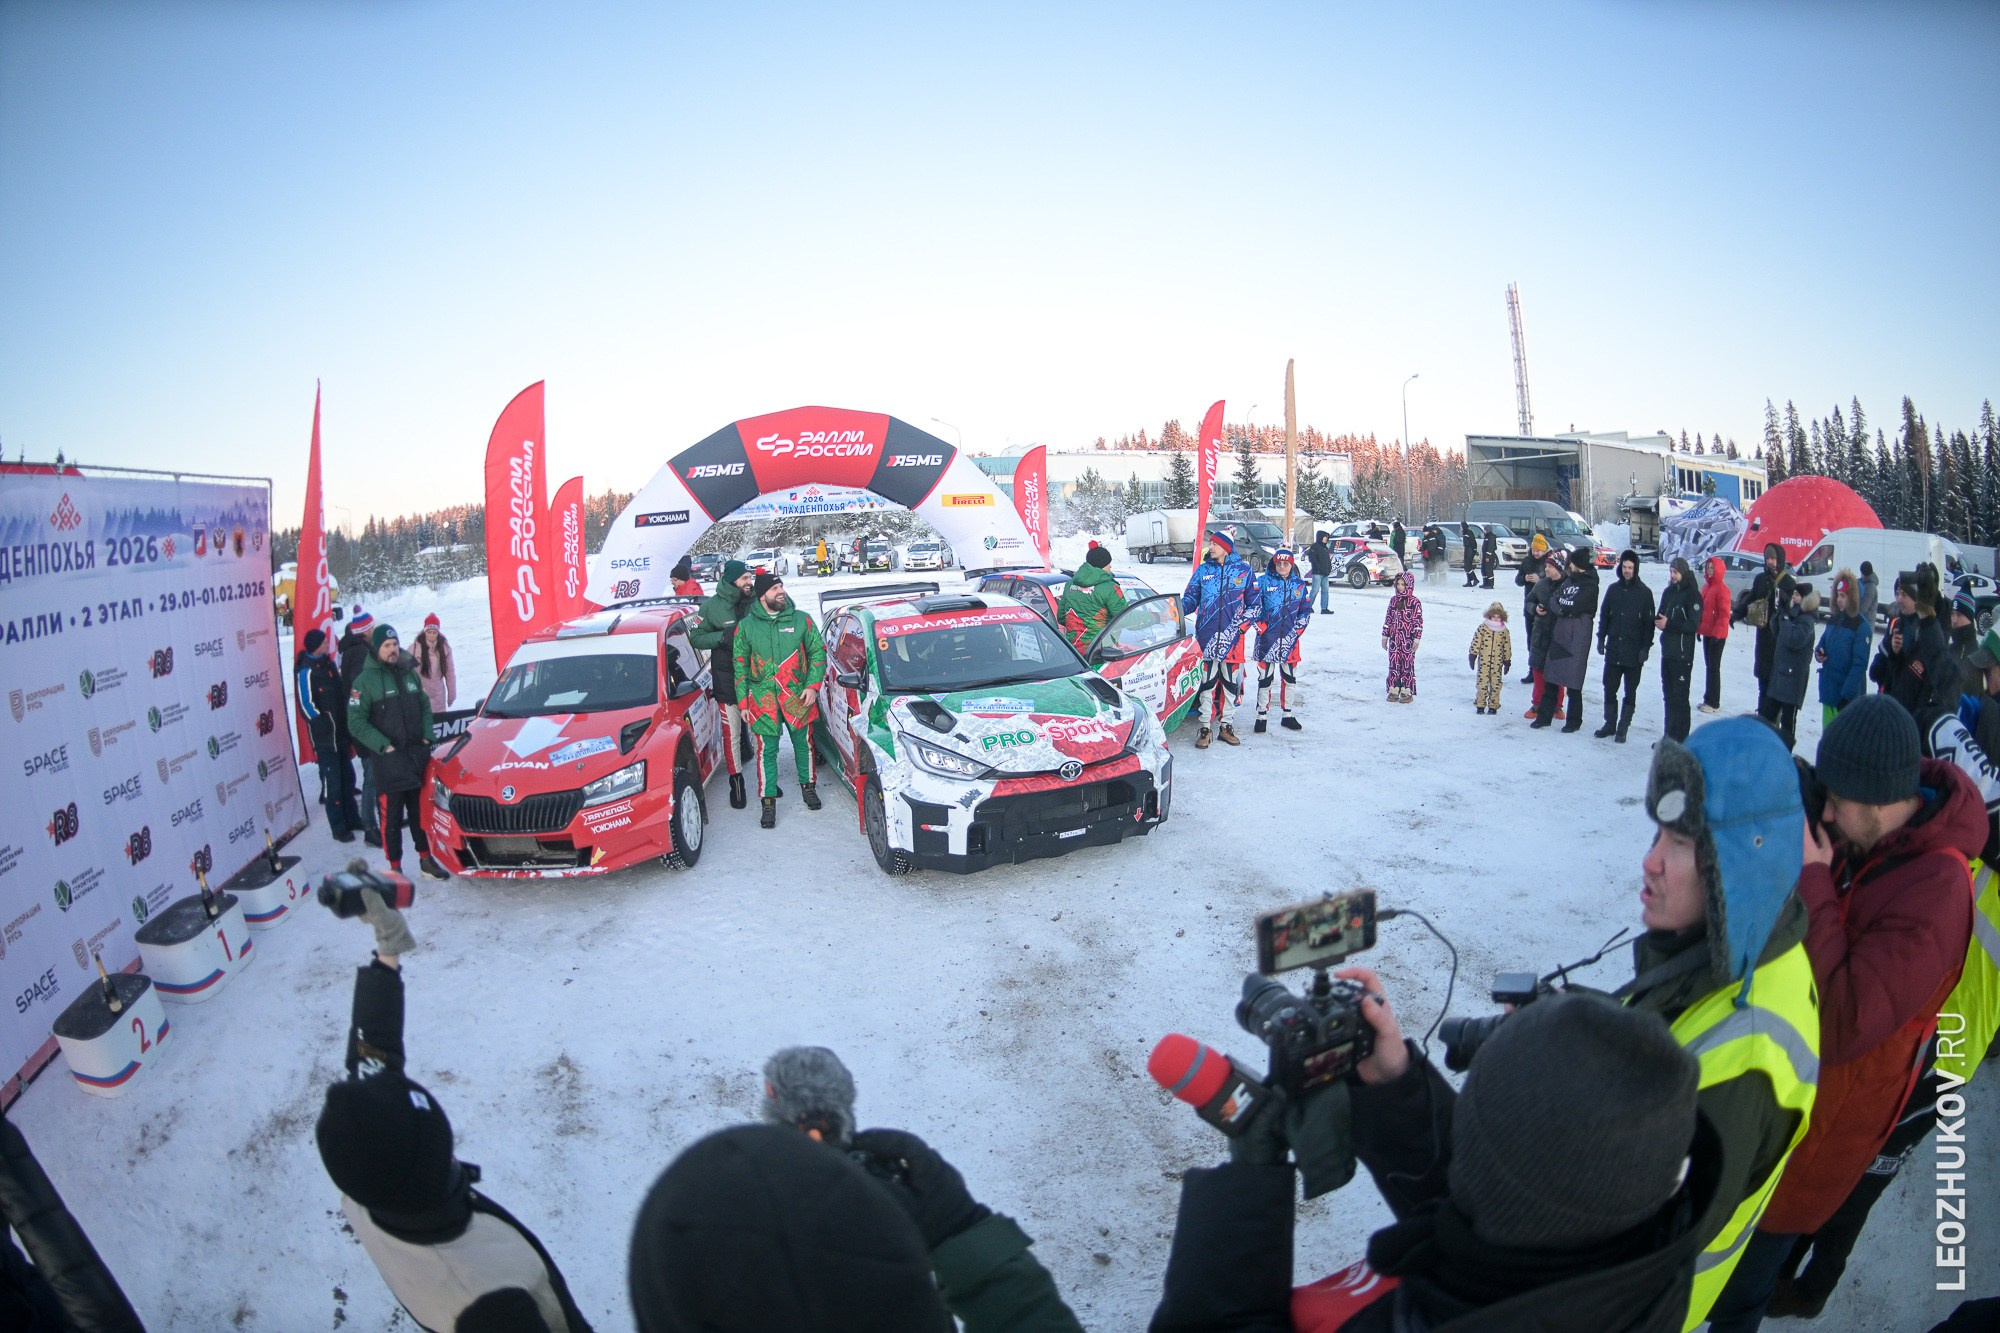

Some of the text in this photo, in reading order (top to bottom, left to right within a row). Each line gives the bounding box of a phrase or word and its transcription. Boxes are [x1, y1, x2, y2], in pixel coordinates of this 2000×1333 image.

[799, 430, 865, 443] РАЛЛИ
[794, 443, 874, 458] РОССИИ
[893, 455, 943, 467] ASMG
[694, 462, 745, 478] ASMG
[510, 456, 523, 560] РАЛЛИ
[522, 440, 539, 562] РОССИИ
[782, 502, 845, 515] ЛАХДЕНПОХЬЯ
[803, 495, 824, 503] 2026
[952, 495, 985, 505] PIRELLI
[649, 513, 688, 524] YOKOHAMA
[563, 510, 573, 565] РАЛЛИ
[571, 503, 580, 567] РОССИИ
[1780, 537, 1813, 547] asmg.ru
[105, 535, 159, 567] 2026
[611, 557, 650, 569] SPACE
[614, 579, 641, 599] R8
[81, 606, 93, 628] 2
[98, 598, 143, 624] ЭТАП
[160, 580, 266, 613] 29.01-01.02.2026
[902, 613, 1018, 631] РАЛЛИ РОССИИ
[194, 638, 224, 657] SPACE
[878, 637, 890, 651] 6
[153, 646, 174, 679] R8
[244, 670, 270, 689] SPACE
[211, 680, 228, 711] R8
[24, 744, 68, 777] SPACE
[489, 761, 549, 772] ADVAN
[103, 774, 142, 805] SPACE
[171, 798, 204, 828] SPACE
[588, 805, 629, 821] RAVENOL
[54, 802, 80, 847] R8
[229, 817, 256, 845] SPACE
[591, 816, 632, 834] YOKOHAMA
[130, 825, 152, 866] R8
[286, 878, 296, 900] 3
[217, 929, 233, 962] 1
[16, 967, 58, 1014] SPACE
[131, 1017, 152, 1055] 2
